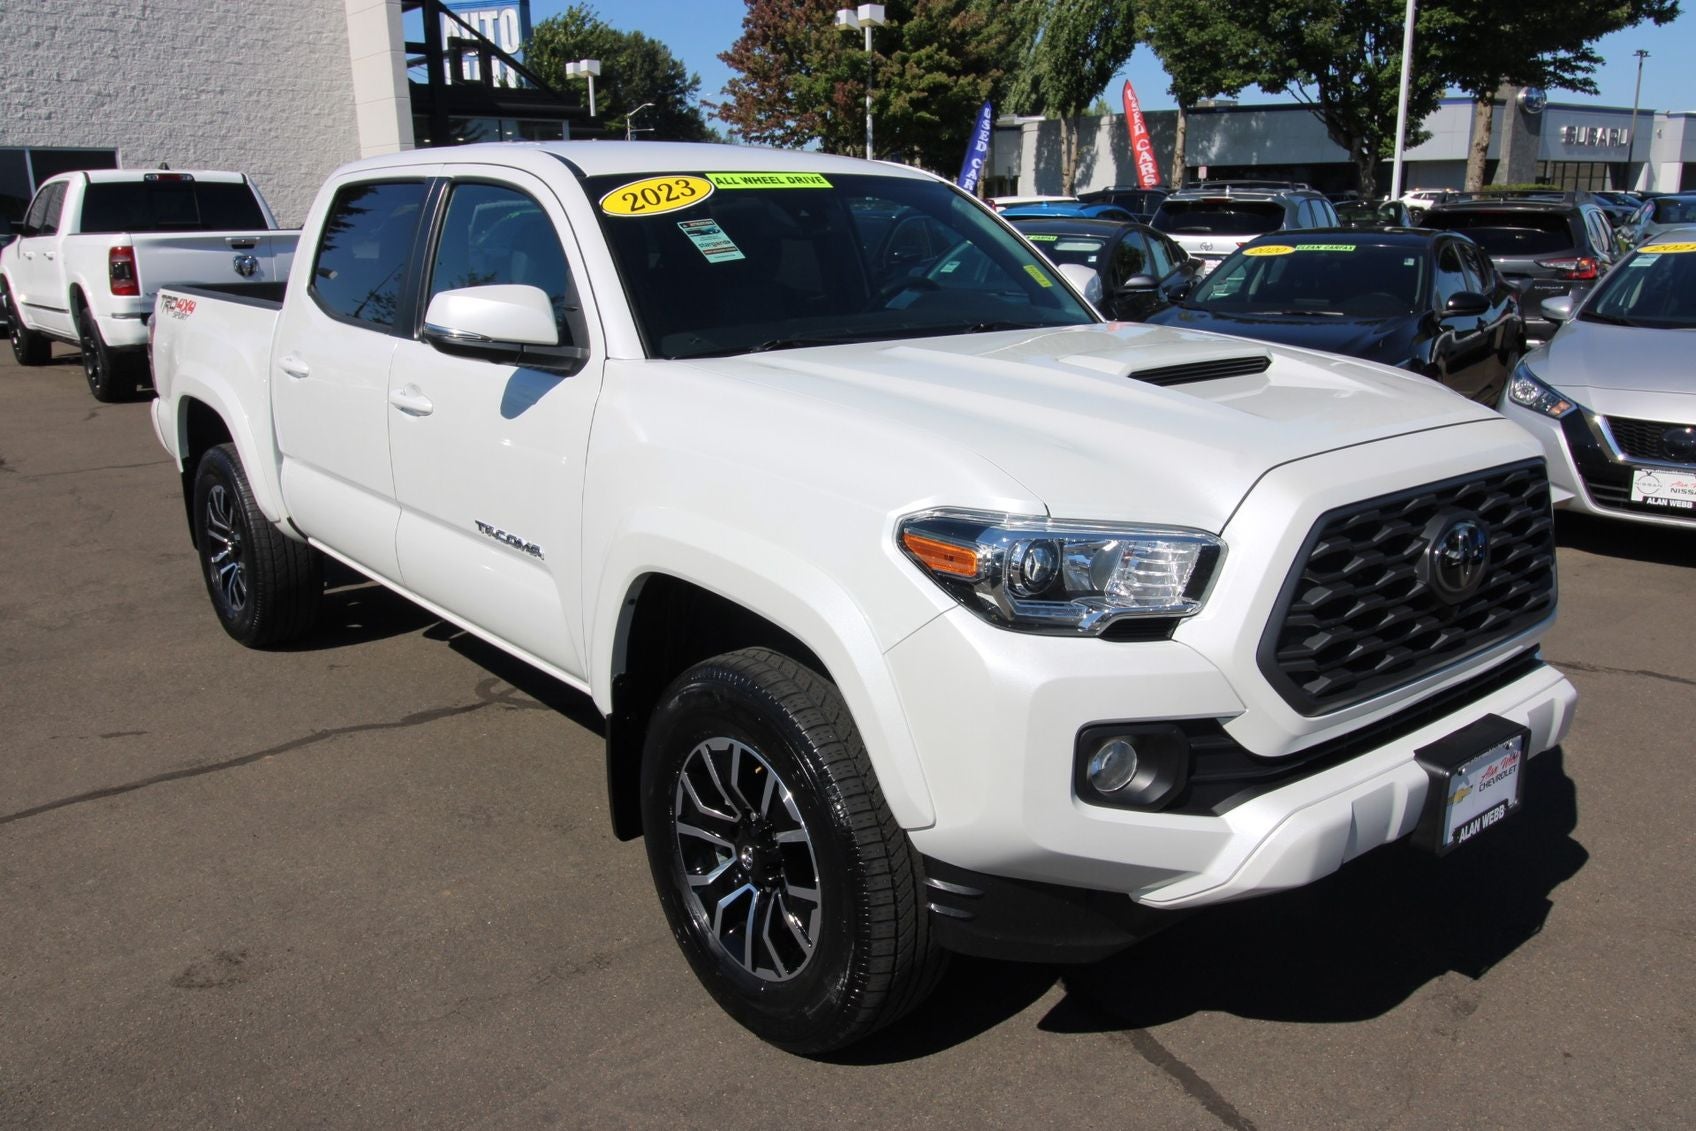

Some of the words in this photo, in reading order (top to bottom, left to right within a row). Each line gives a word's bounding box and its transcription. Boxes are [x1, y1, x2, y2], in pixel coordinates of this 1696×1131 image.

[975, 107, 991, 152] USED
[1560, 126, 1630, 147] SUBARU
[1136, 139, 1157, 186] CARS
[621, 179, 697, 212] 2023
[715, 176, 740, 185] ALL
[741, 175, 785, 185] WHEEL
[787, 175, 825, 185] DRIVE
[1647, 497, 1668, 506] ALAN
[1669, 499, 1693, 509] WEBB
[474, 519, 545, 561] TACOMA
[1479, 764, 1518, 792] CHEVROLET
[1458, 818, 1481, 843] ALAN
[1482, 804, 1505, 829] WEBB
